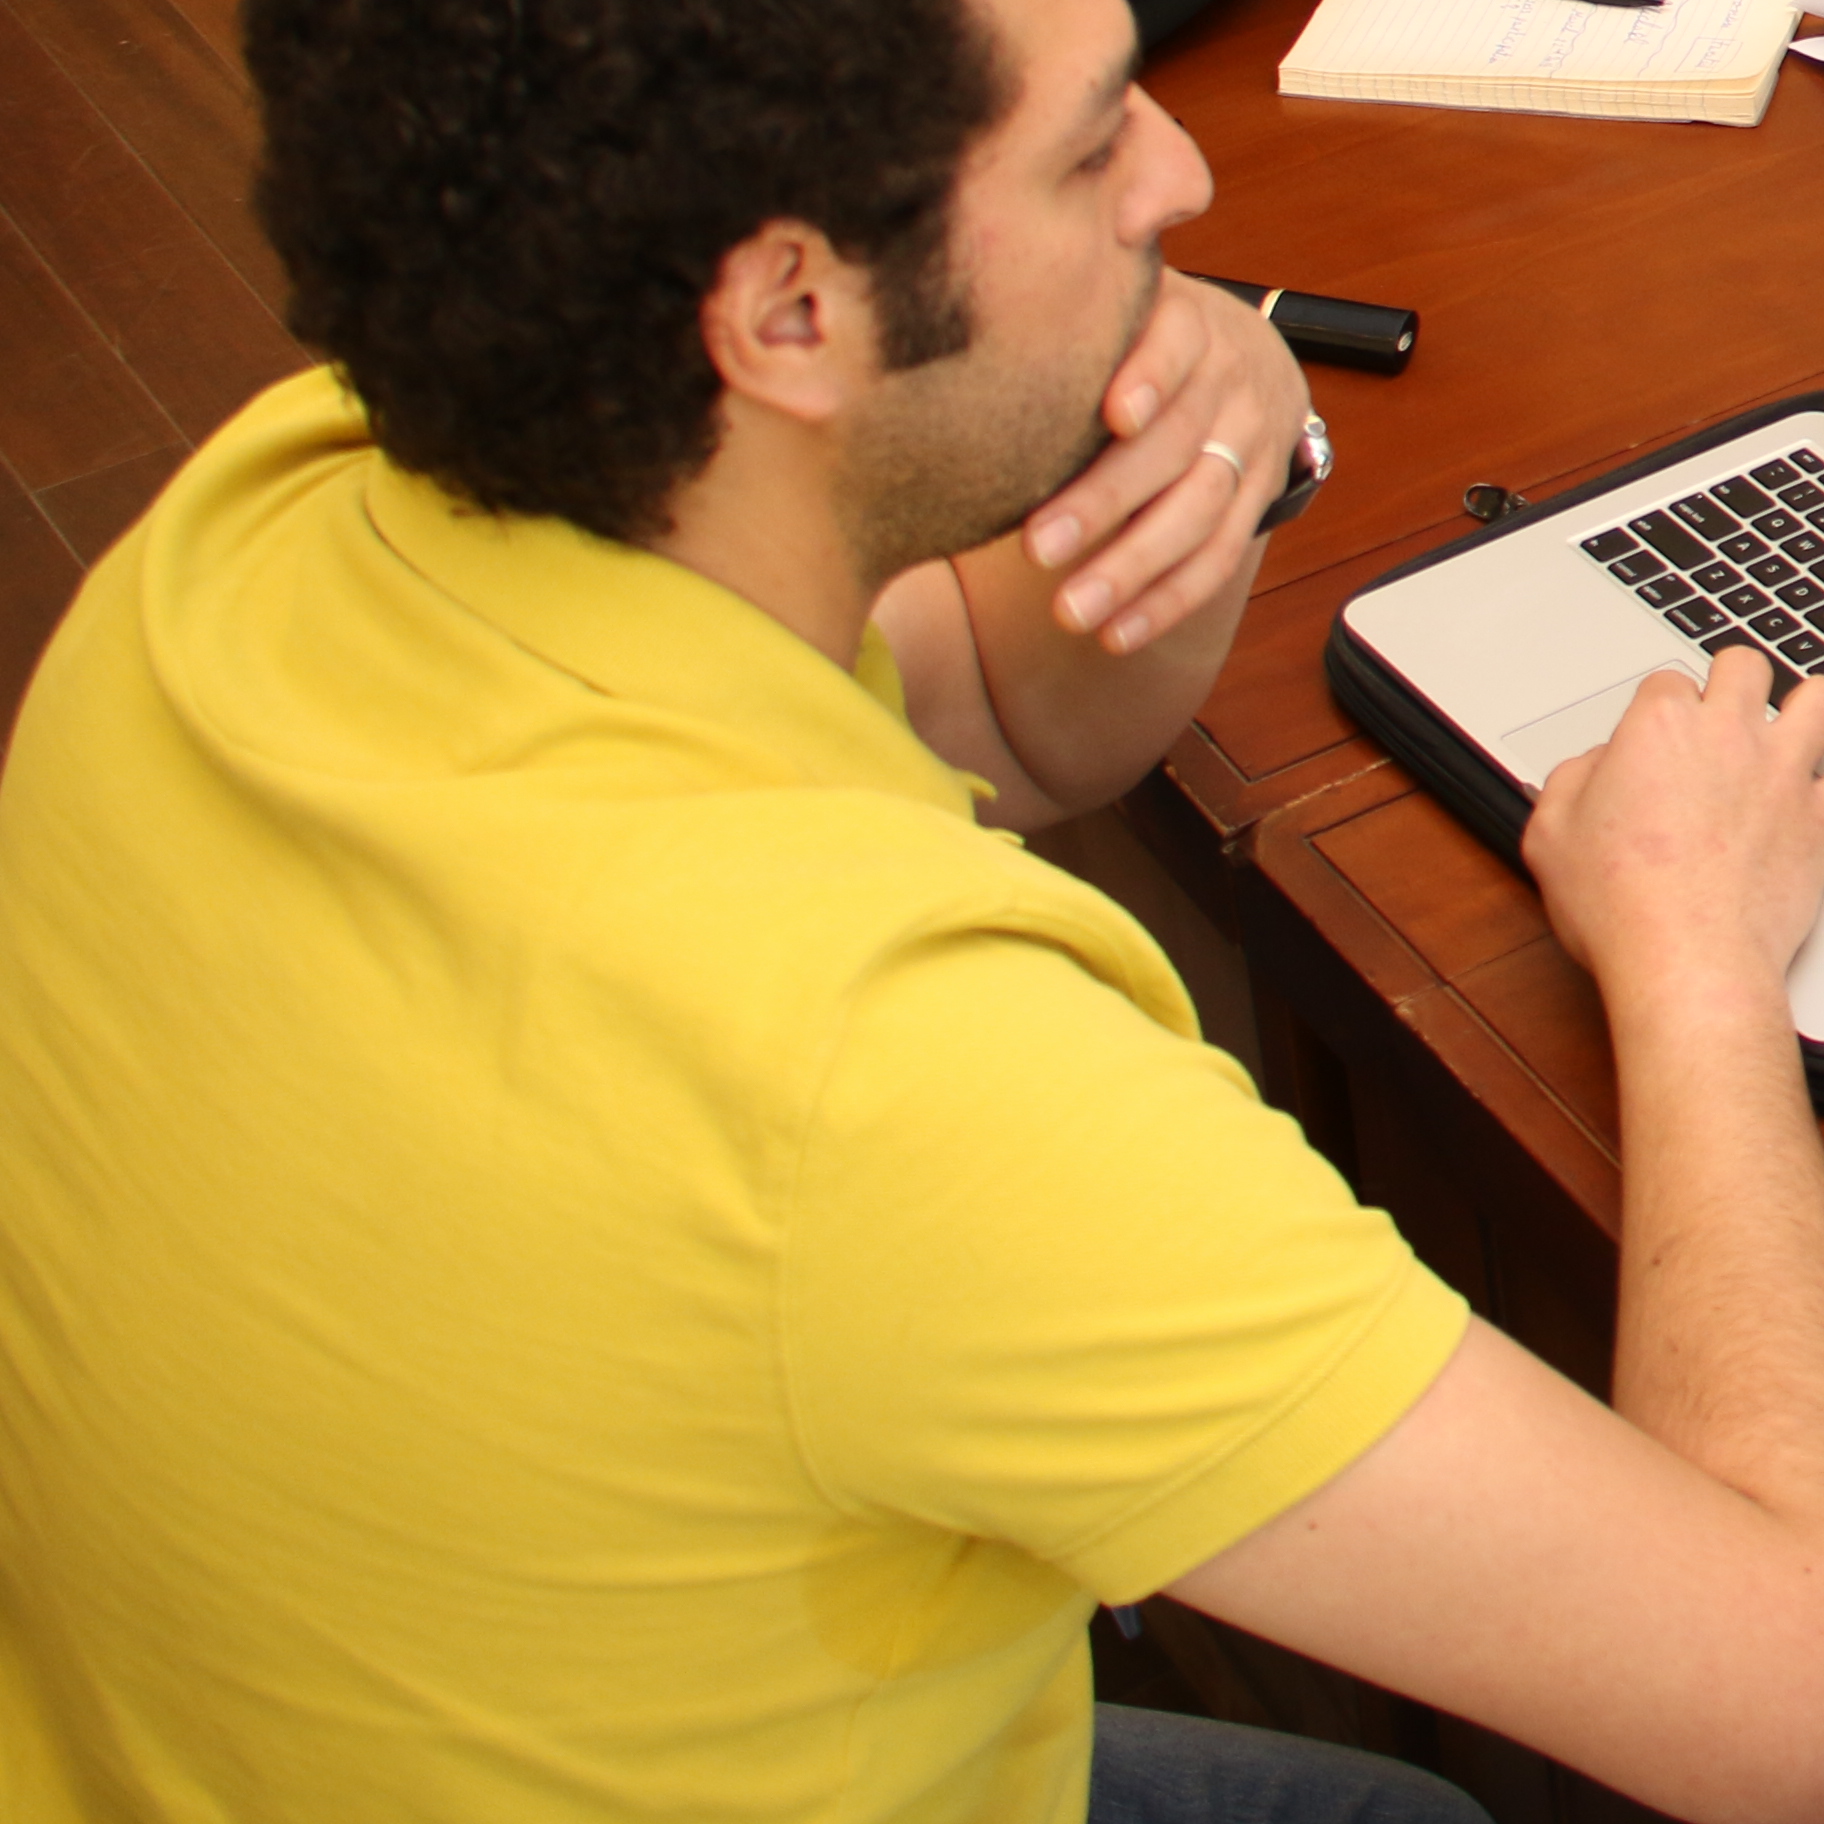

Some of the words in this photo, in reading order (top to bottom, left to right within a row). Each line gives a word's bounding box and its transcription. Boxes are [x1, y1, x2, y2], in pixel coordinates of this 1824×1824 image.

[1799, 539, 1815, 552] W
[1766, 564, 1781, 574] S
[1795, 587, 1810, 597] D
